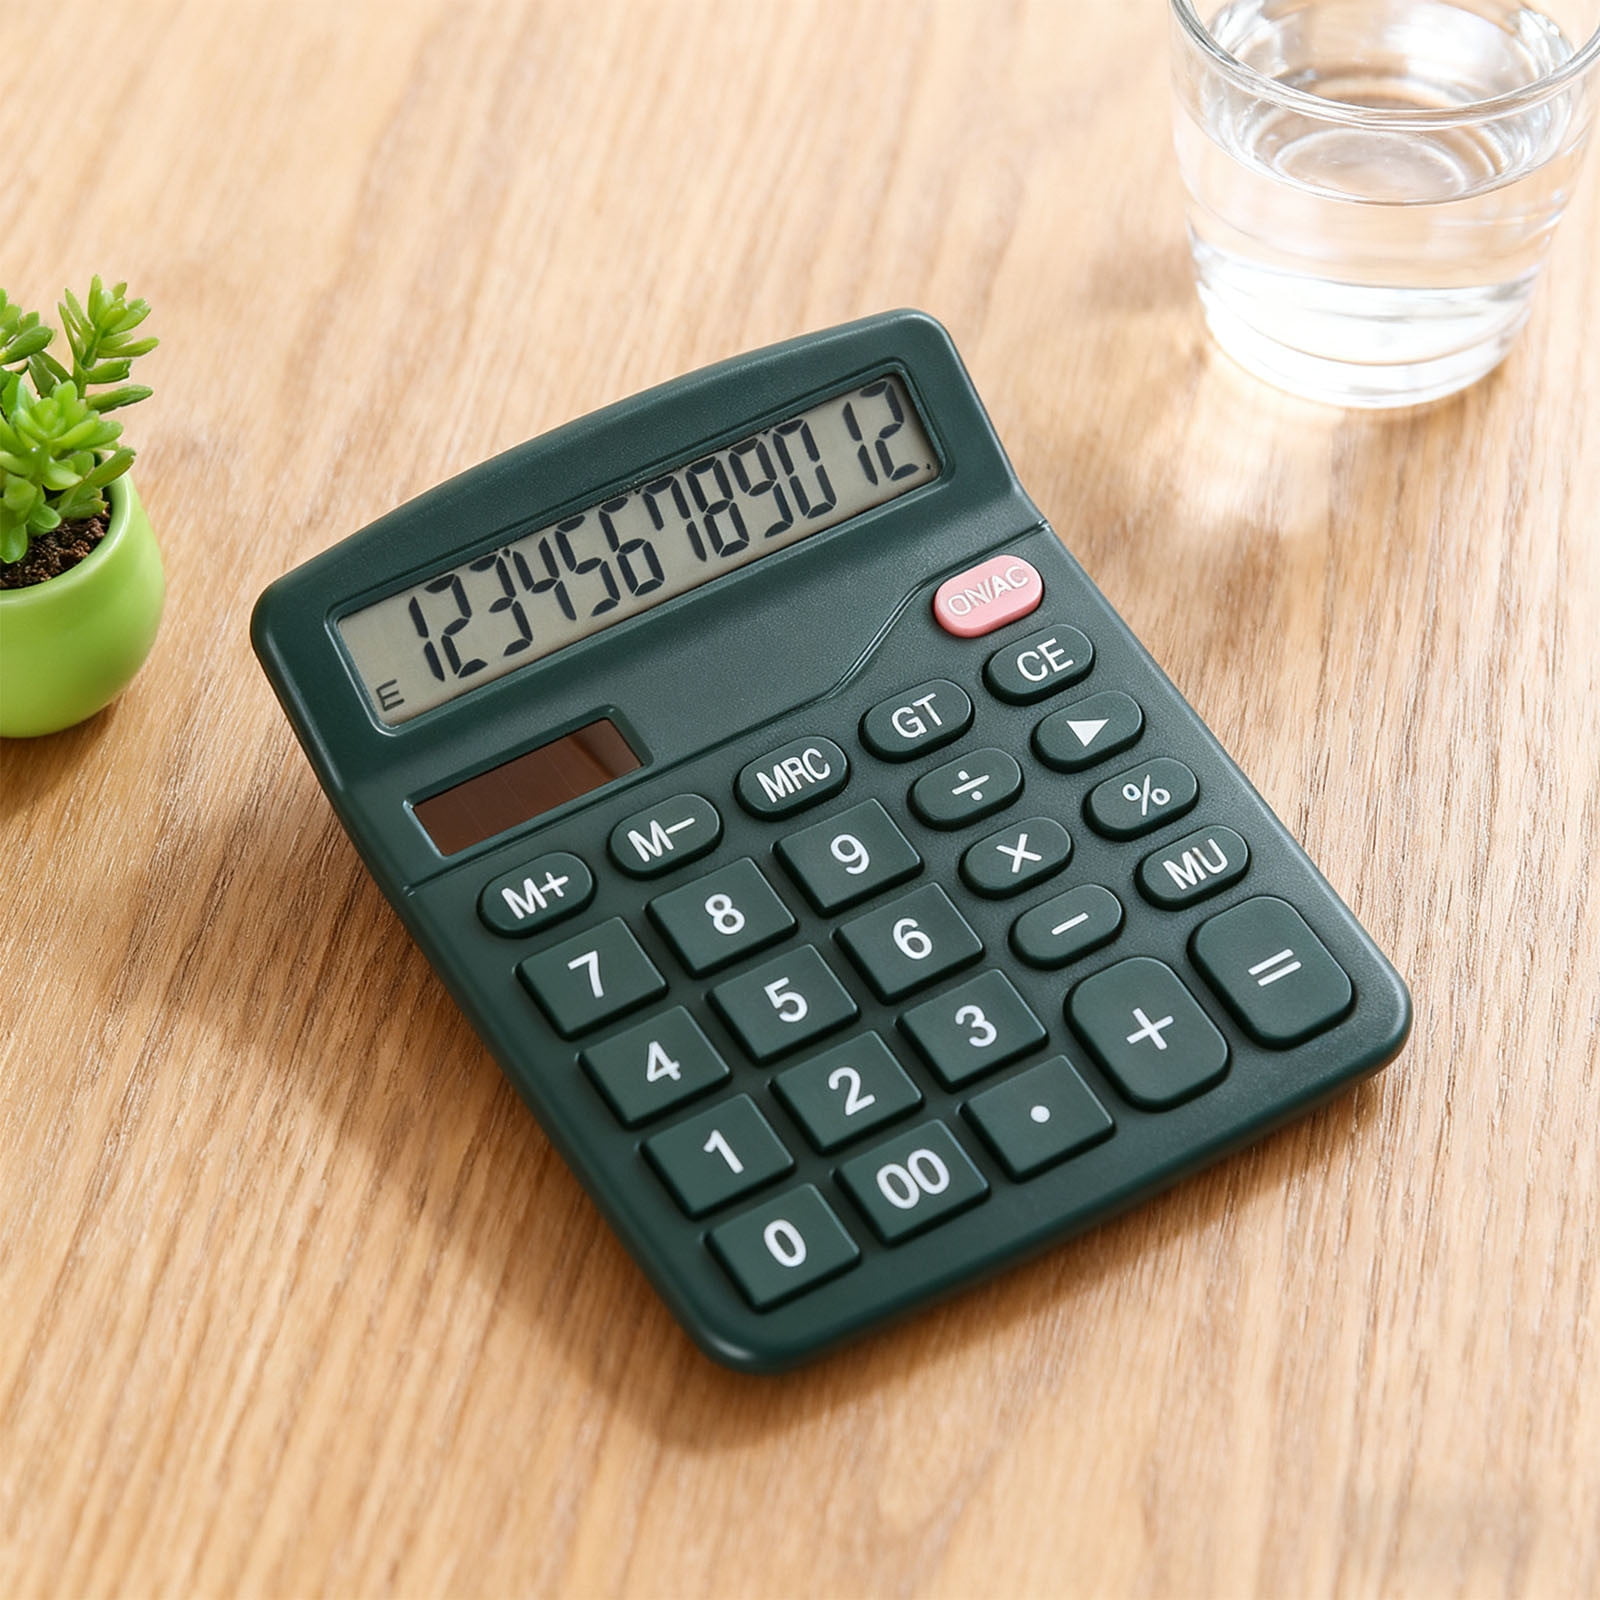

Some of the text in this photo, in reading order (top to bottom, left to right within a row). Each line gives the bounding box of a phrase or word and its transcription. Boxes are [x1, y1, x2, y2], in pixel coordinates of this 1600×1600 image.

[947, 565, 1029, 616] ON/AC
[1017, 638, 1073, 681] CE
[375, 679, 405, 712] E
[892, 693, 943, 738] GT
[756, 747, 831, 803] MRC
[1122, 774, 1171, 816] %
[830, 834, 870, 875] 9
[1162, 838, 1228, 890] MU
[501, 871, 568, 919] M+
[704, 893, 745, 935] 8
[893, 918, 933, 960] 6
[567, 950, 604, 998] 7
[764, 977, 808, 1023] 5
[955, 1004, 997, 1047] 3
[646, 1041, 681, 1082] 4
[828, 1067, 876, 1116] 2
[703, 1130, 744, 1174] 1
[877, 1149, 950, 1209] 00
[763, 1219, 807, 1267] 0
